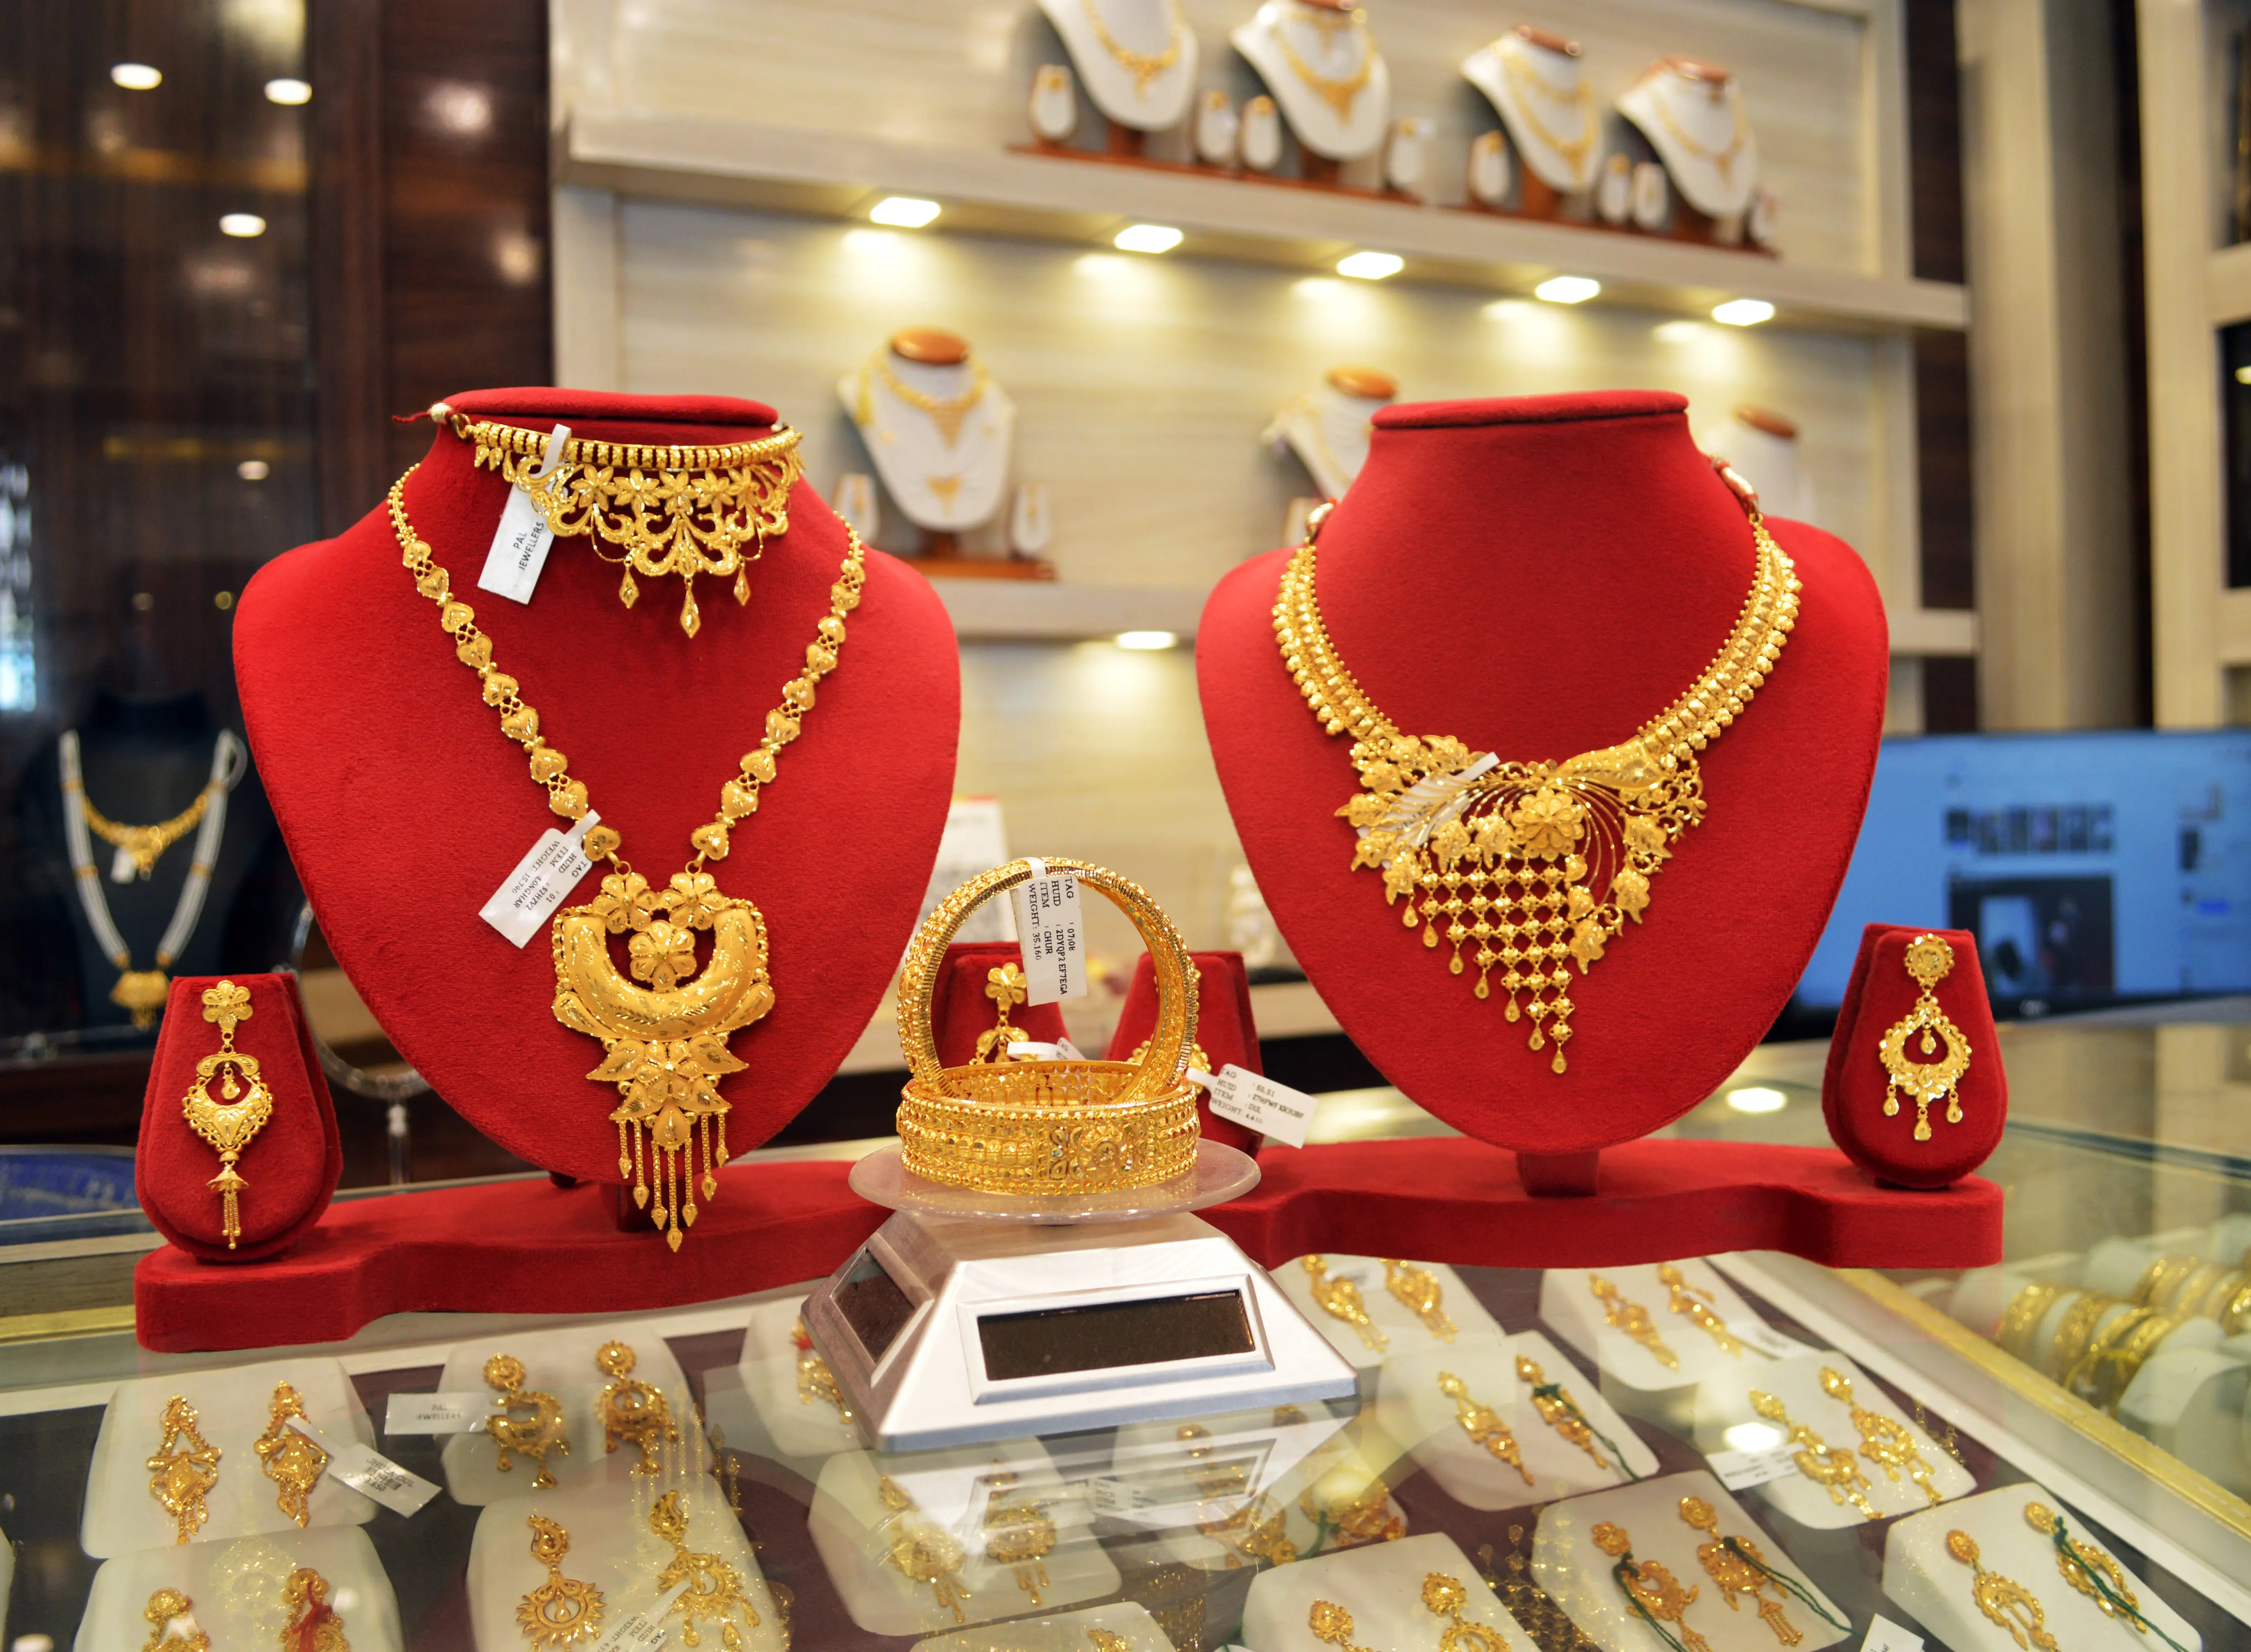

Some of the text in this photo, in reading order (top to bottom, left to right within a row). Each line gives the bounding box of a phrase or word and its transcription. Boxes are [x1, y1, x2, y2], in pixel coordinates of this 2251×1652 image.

[513, 532, 527, 549] PAL
[518, 522, 544, 571] JEWELLERS
[550, 846, 568, 867] ITEM
[559, 853, 577, 873] HUID
[512, 873, 530, 893] 15.790
[546, 862, 587, 903] TAG 01
[1065, 876, 1074, 899] TAG
[1040, 882, 1053, 954] ITEM CHUR
[1033, 933, 1042, 960] 35.160
[1052, 880, 1068, 995] HUID 2DYQP2 EF7EGA
[1220, 1068, 1237, 1078] TAG
[1213, 1088, 1233, 1101] ITEM
[629, 1620, 648, 1638] ITEM
[638, 1625, 656, 1642] HUID
